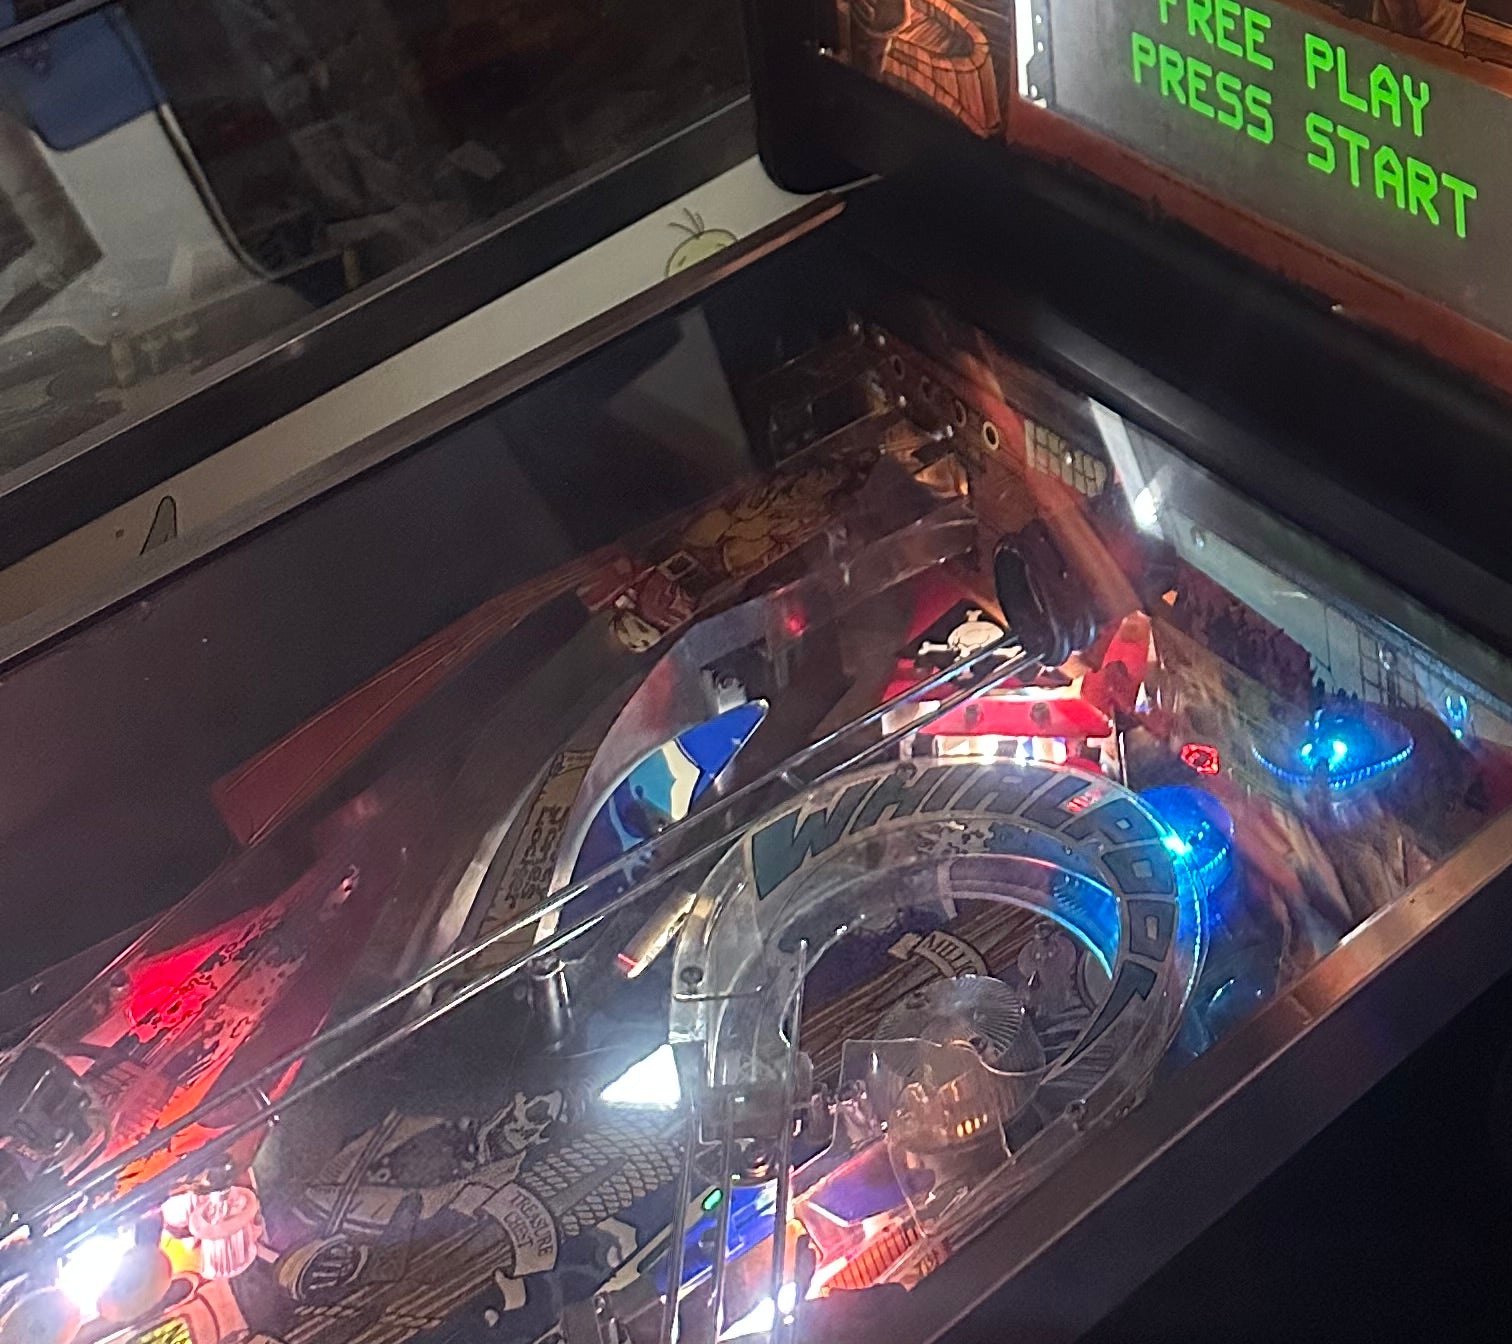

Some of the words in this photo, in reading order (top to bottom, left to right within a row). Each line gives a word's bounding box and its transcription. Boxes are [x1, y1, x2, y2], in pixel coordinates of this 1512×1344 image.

[1130, 31, 1275, 145] PRESS
[1304, 111, 1478, 239] START
[1304, 32, 1432, 138] PLAY
[749, 763, 1178, 1068] WHIRLPOOL
[511, 1190, 554, 1257] TREASURE
